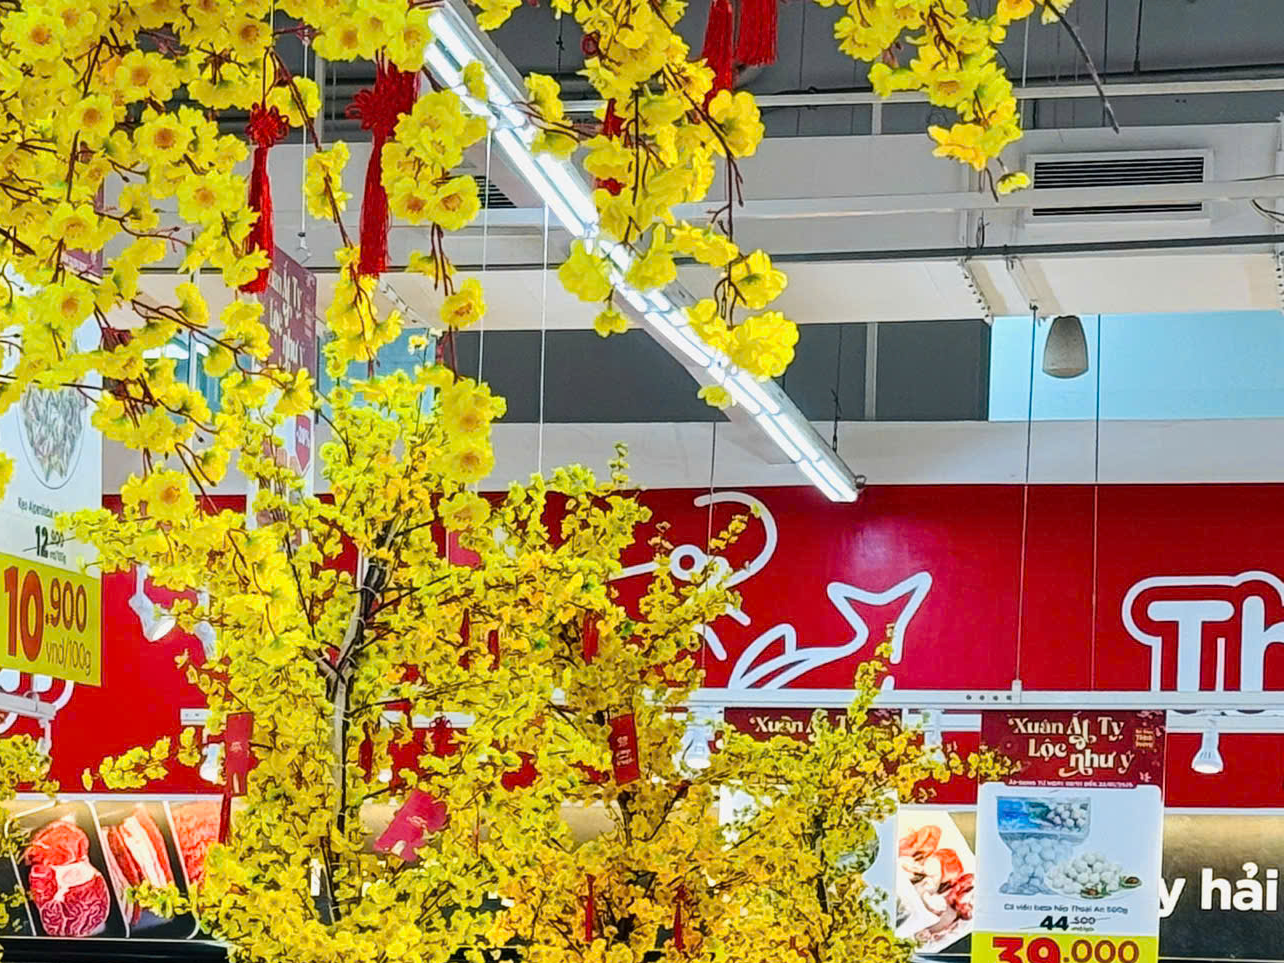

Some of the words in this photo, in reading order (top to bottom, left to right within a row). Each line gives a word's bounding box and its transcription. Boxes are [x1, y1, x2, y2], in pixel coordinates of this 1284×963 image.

[4, 565, 87, 662] 10.900
[46, 638, 92, 676] vnd/100g
[1008, 718, 1063, 734] Xuân
[1098, 717, 1125, 741] Tỵ
[1028, 739, 1066, 761] Lộc
[1058, 750, 1116, 777] như
[1201, 862, 1279, 911] hải
